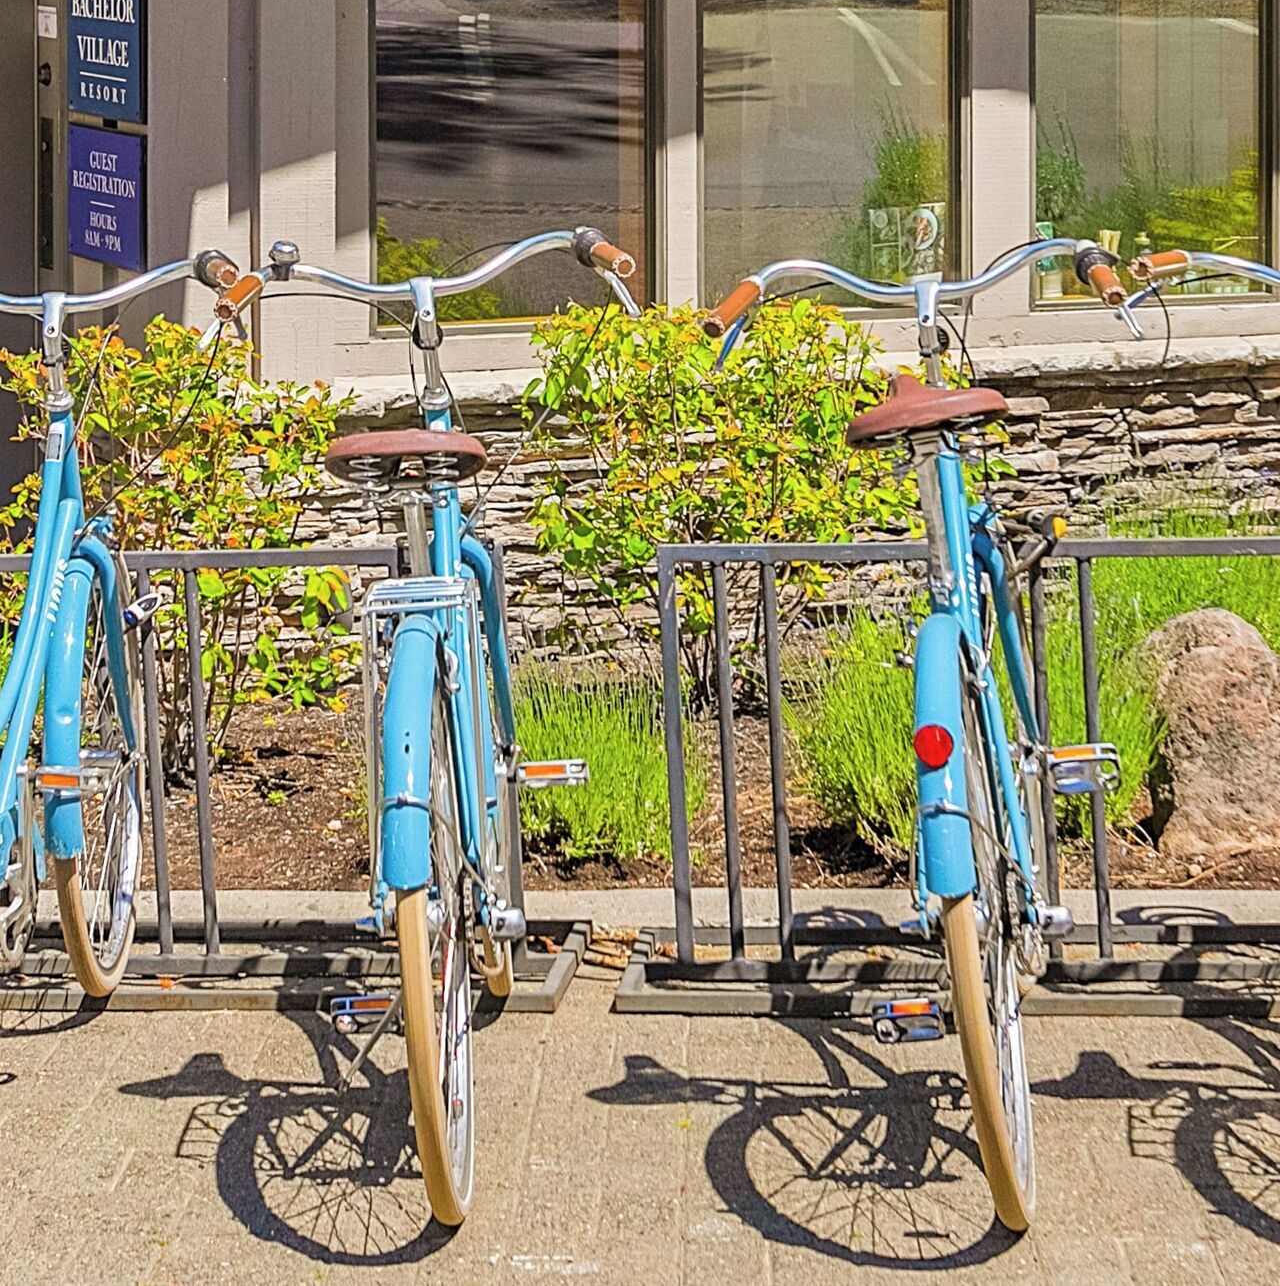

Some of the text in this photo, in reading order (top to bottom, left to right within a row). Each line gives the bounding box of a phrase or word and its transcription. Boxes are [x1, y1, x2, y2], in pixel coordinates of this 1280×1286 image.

[76, 34, 130, 68] VILLAGE
[80, 81, 127, 105] RESORT
[89, 151, 118, 172] GUEST
[73, 169, 136, 199] REGISTRATION
[90, 211, 117, 231] HOURS
